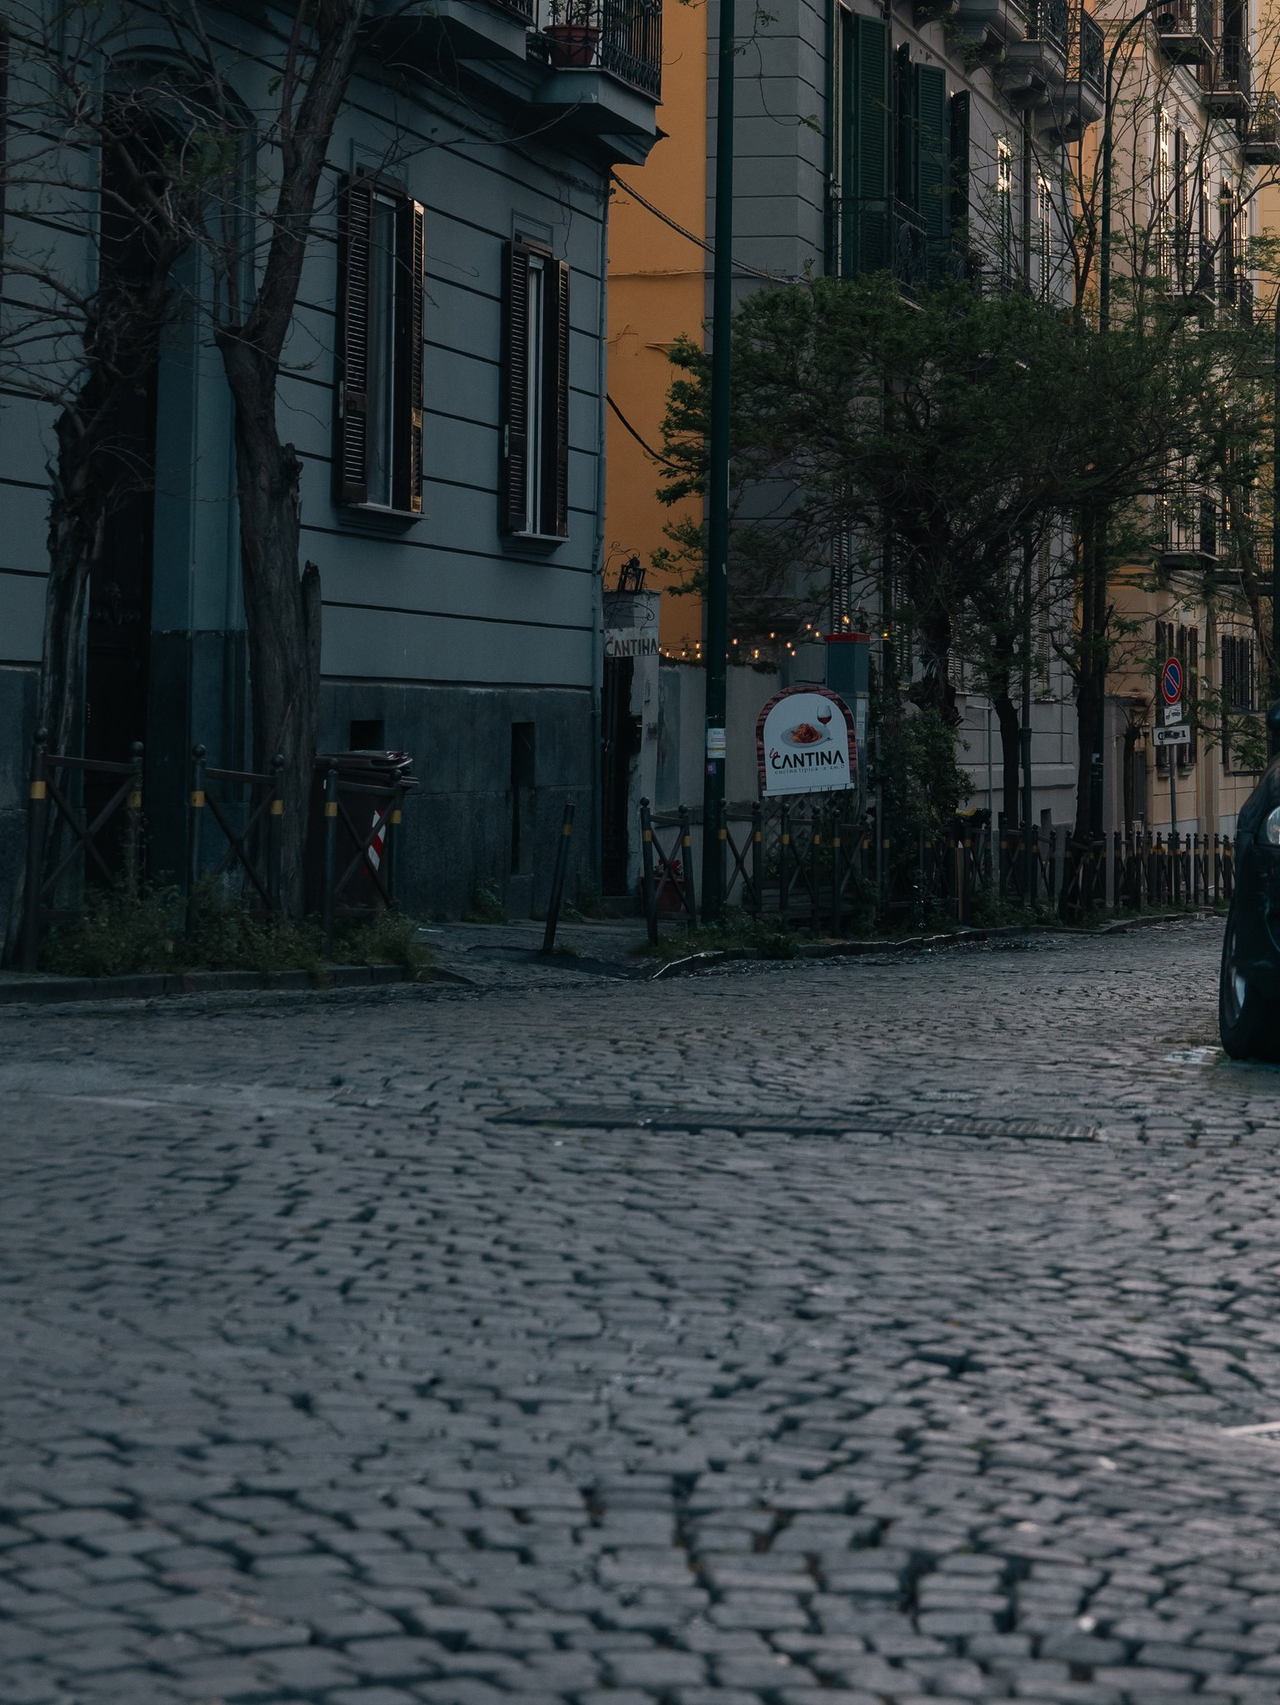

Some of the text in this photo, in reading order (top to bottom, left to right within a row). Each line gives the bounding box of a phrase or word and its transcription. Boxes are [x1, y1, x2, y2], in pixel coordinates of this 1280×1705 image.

[605, 638, 658, 657] CANTINA
[769, 747, 781, 759] la
[771, 749, 845, 770] CANTINA
